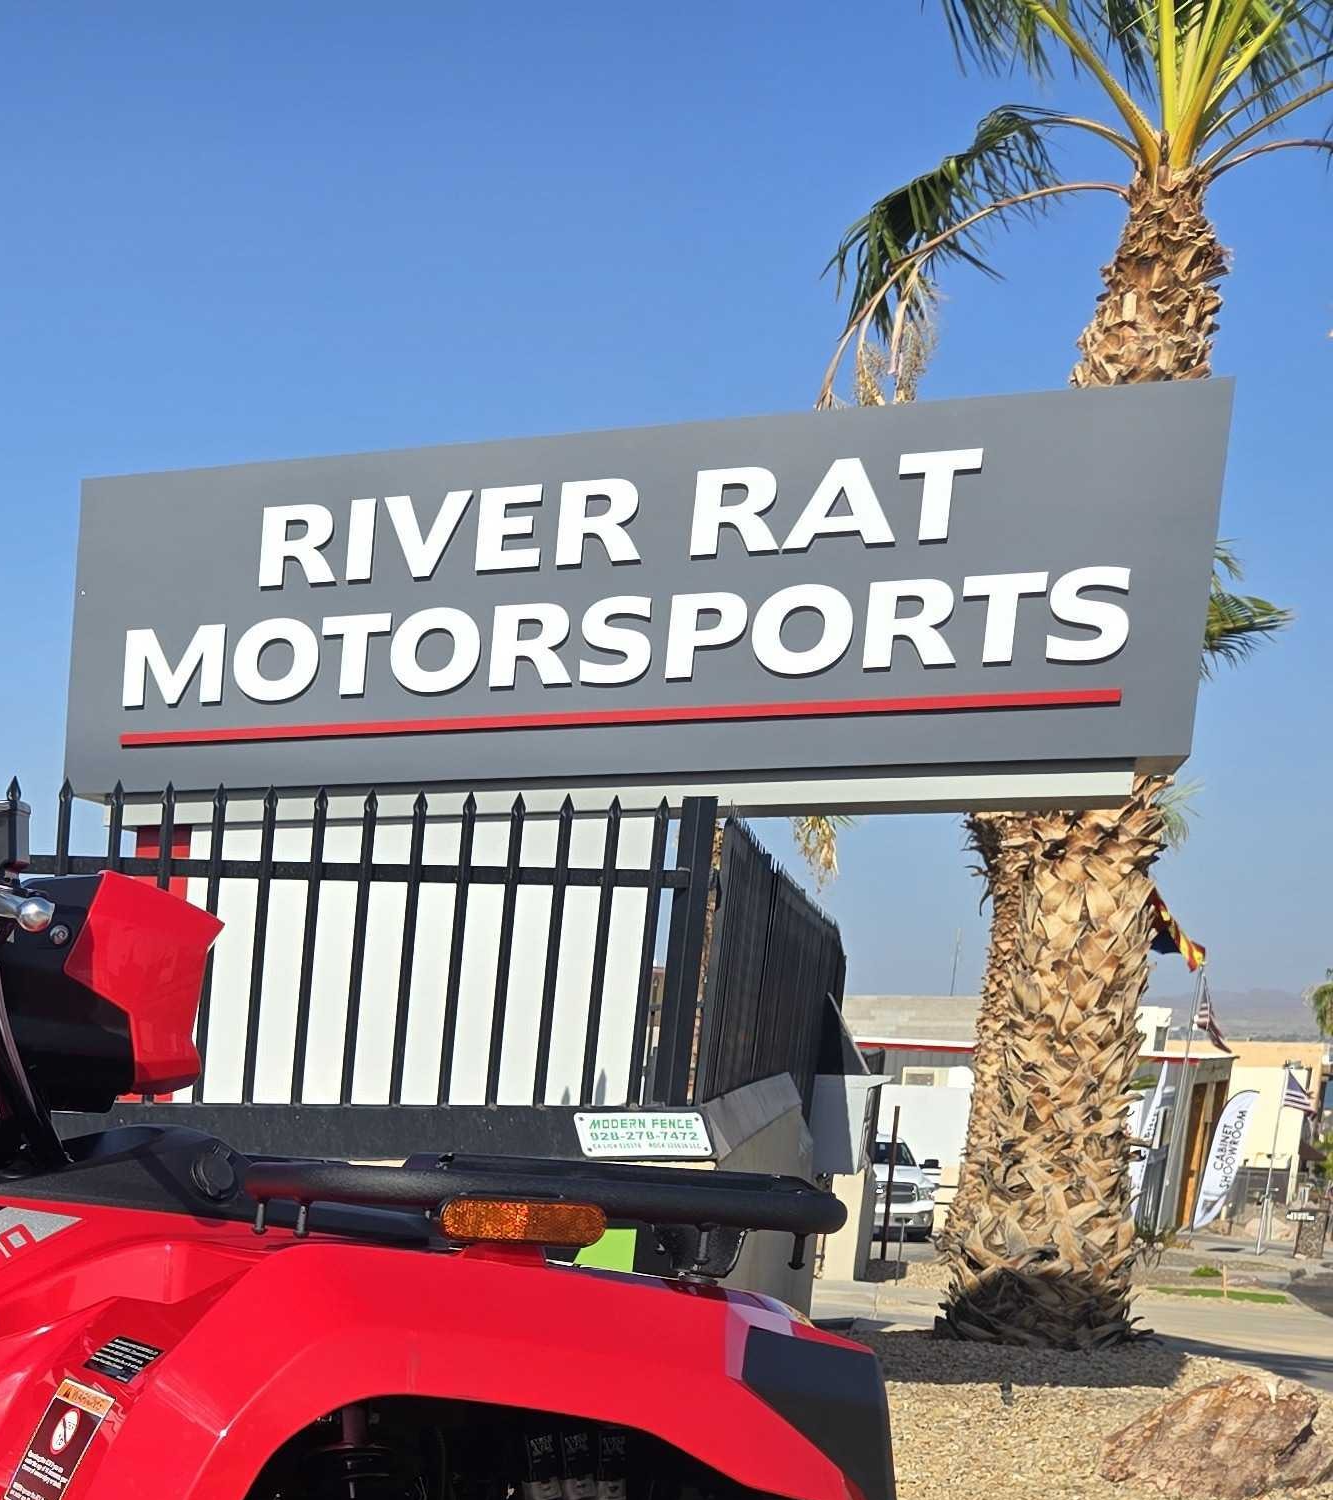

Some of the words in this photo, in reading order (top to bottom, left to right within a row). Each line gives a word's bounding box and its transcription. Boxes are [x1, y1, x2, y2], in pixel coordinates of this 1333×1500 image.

[258, 479, 641, 588] RIVER
[689, 447, 984, 558] RAT
[121, 566, 1133, 709] MOTORSPORTS
[589, 1118, 646, 1130] MODERN
[651, 1118, 694, 1130] FENCE
[1213, 1123, 1233, 1171] CABINET
